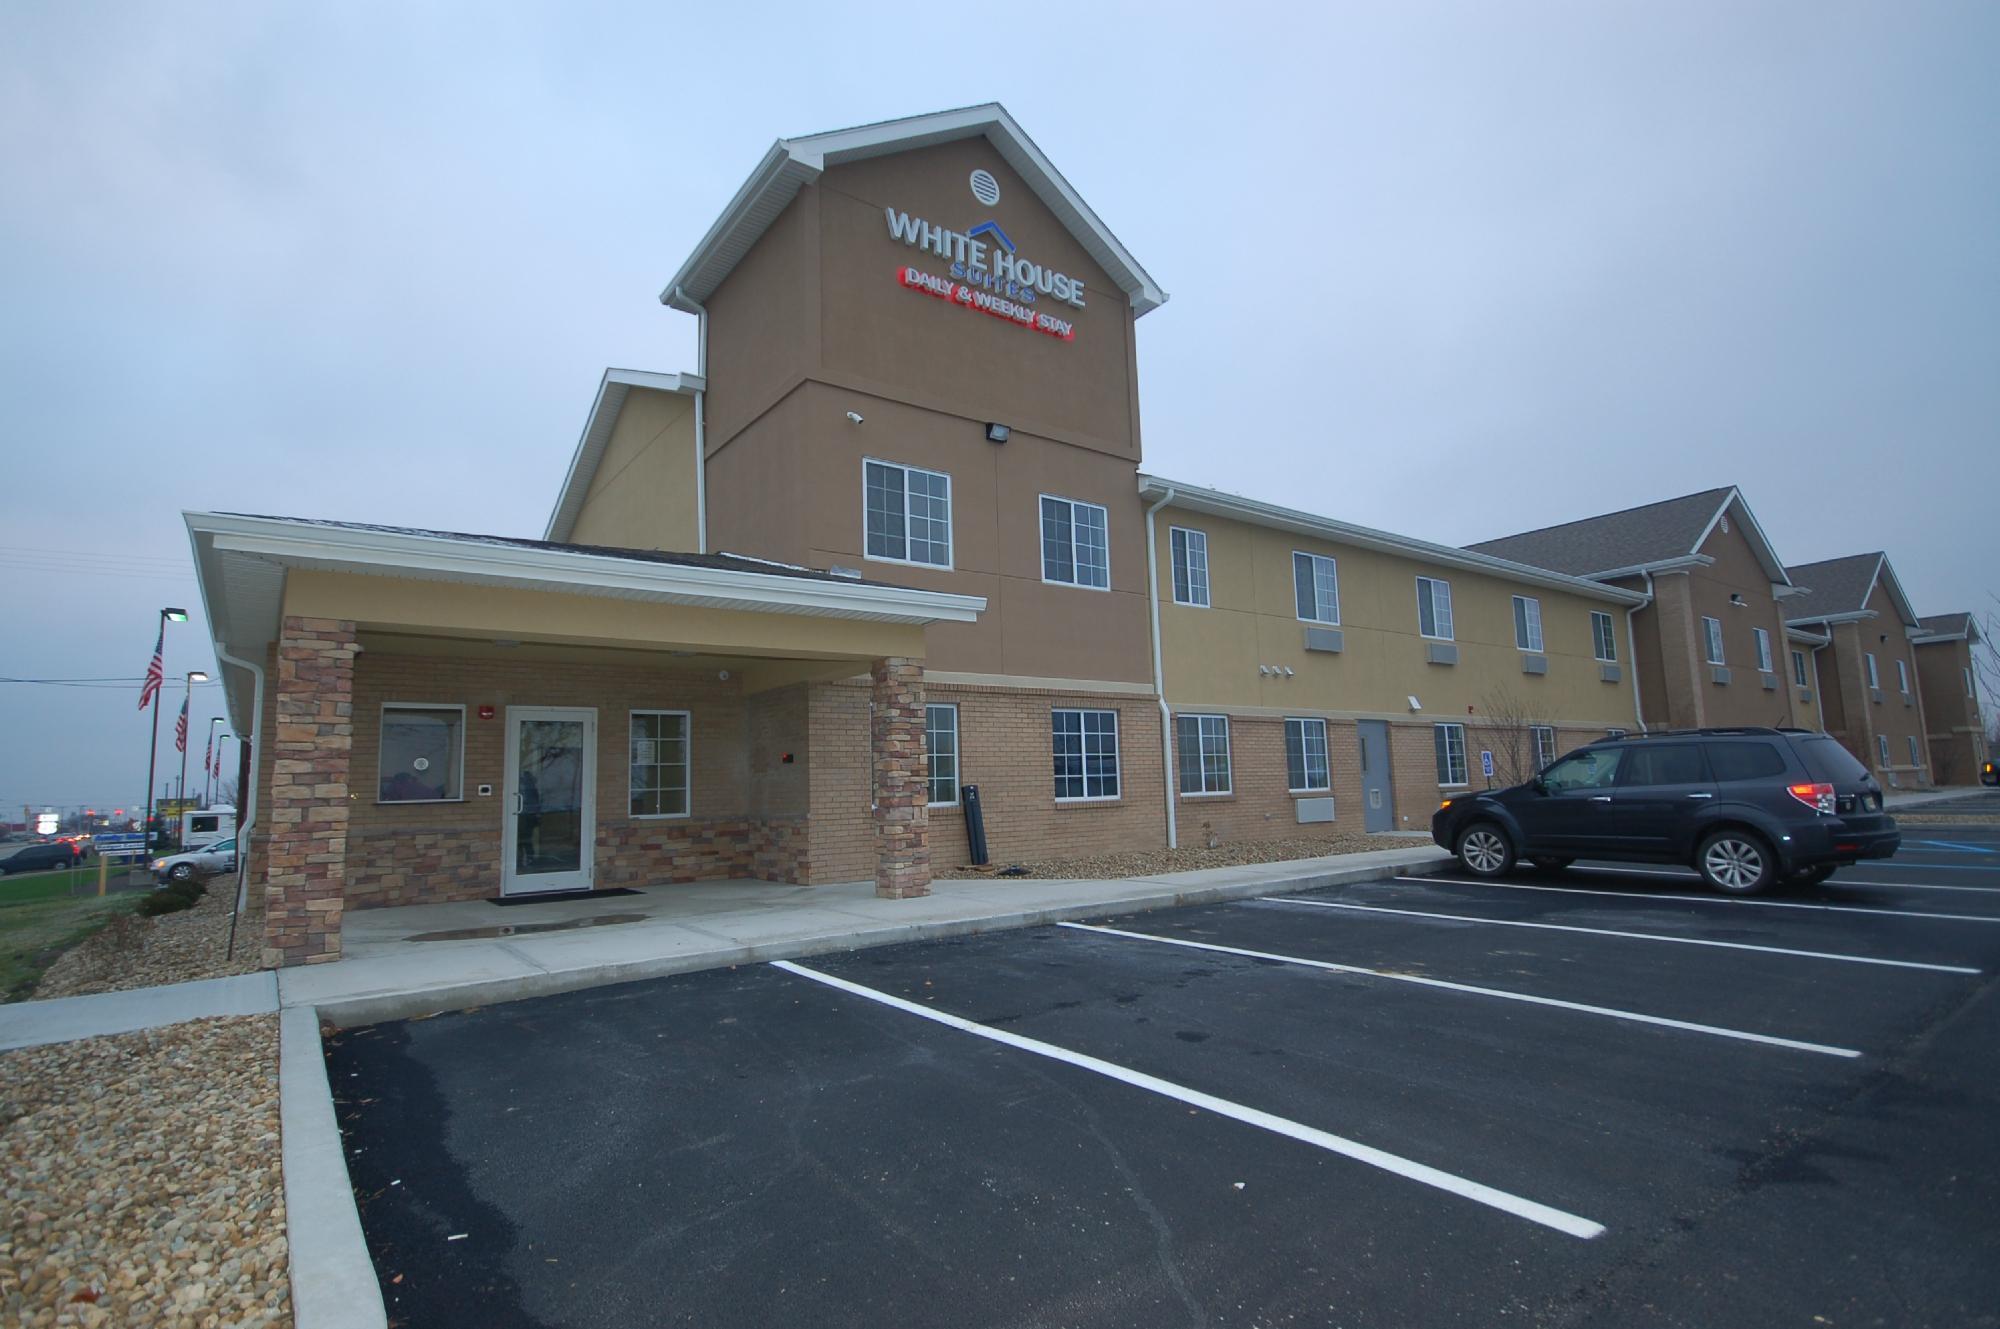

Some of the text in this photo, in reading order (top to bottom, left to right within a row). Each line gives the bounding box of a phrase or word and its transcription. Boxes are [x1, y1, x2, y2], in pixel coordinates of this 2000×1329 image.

[885, 206, 1086, 309] WHITE HOUSE
[905, 267, 1073, 337] DAILY & WEEKLY STAY
